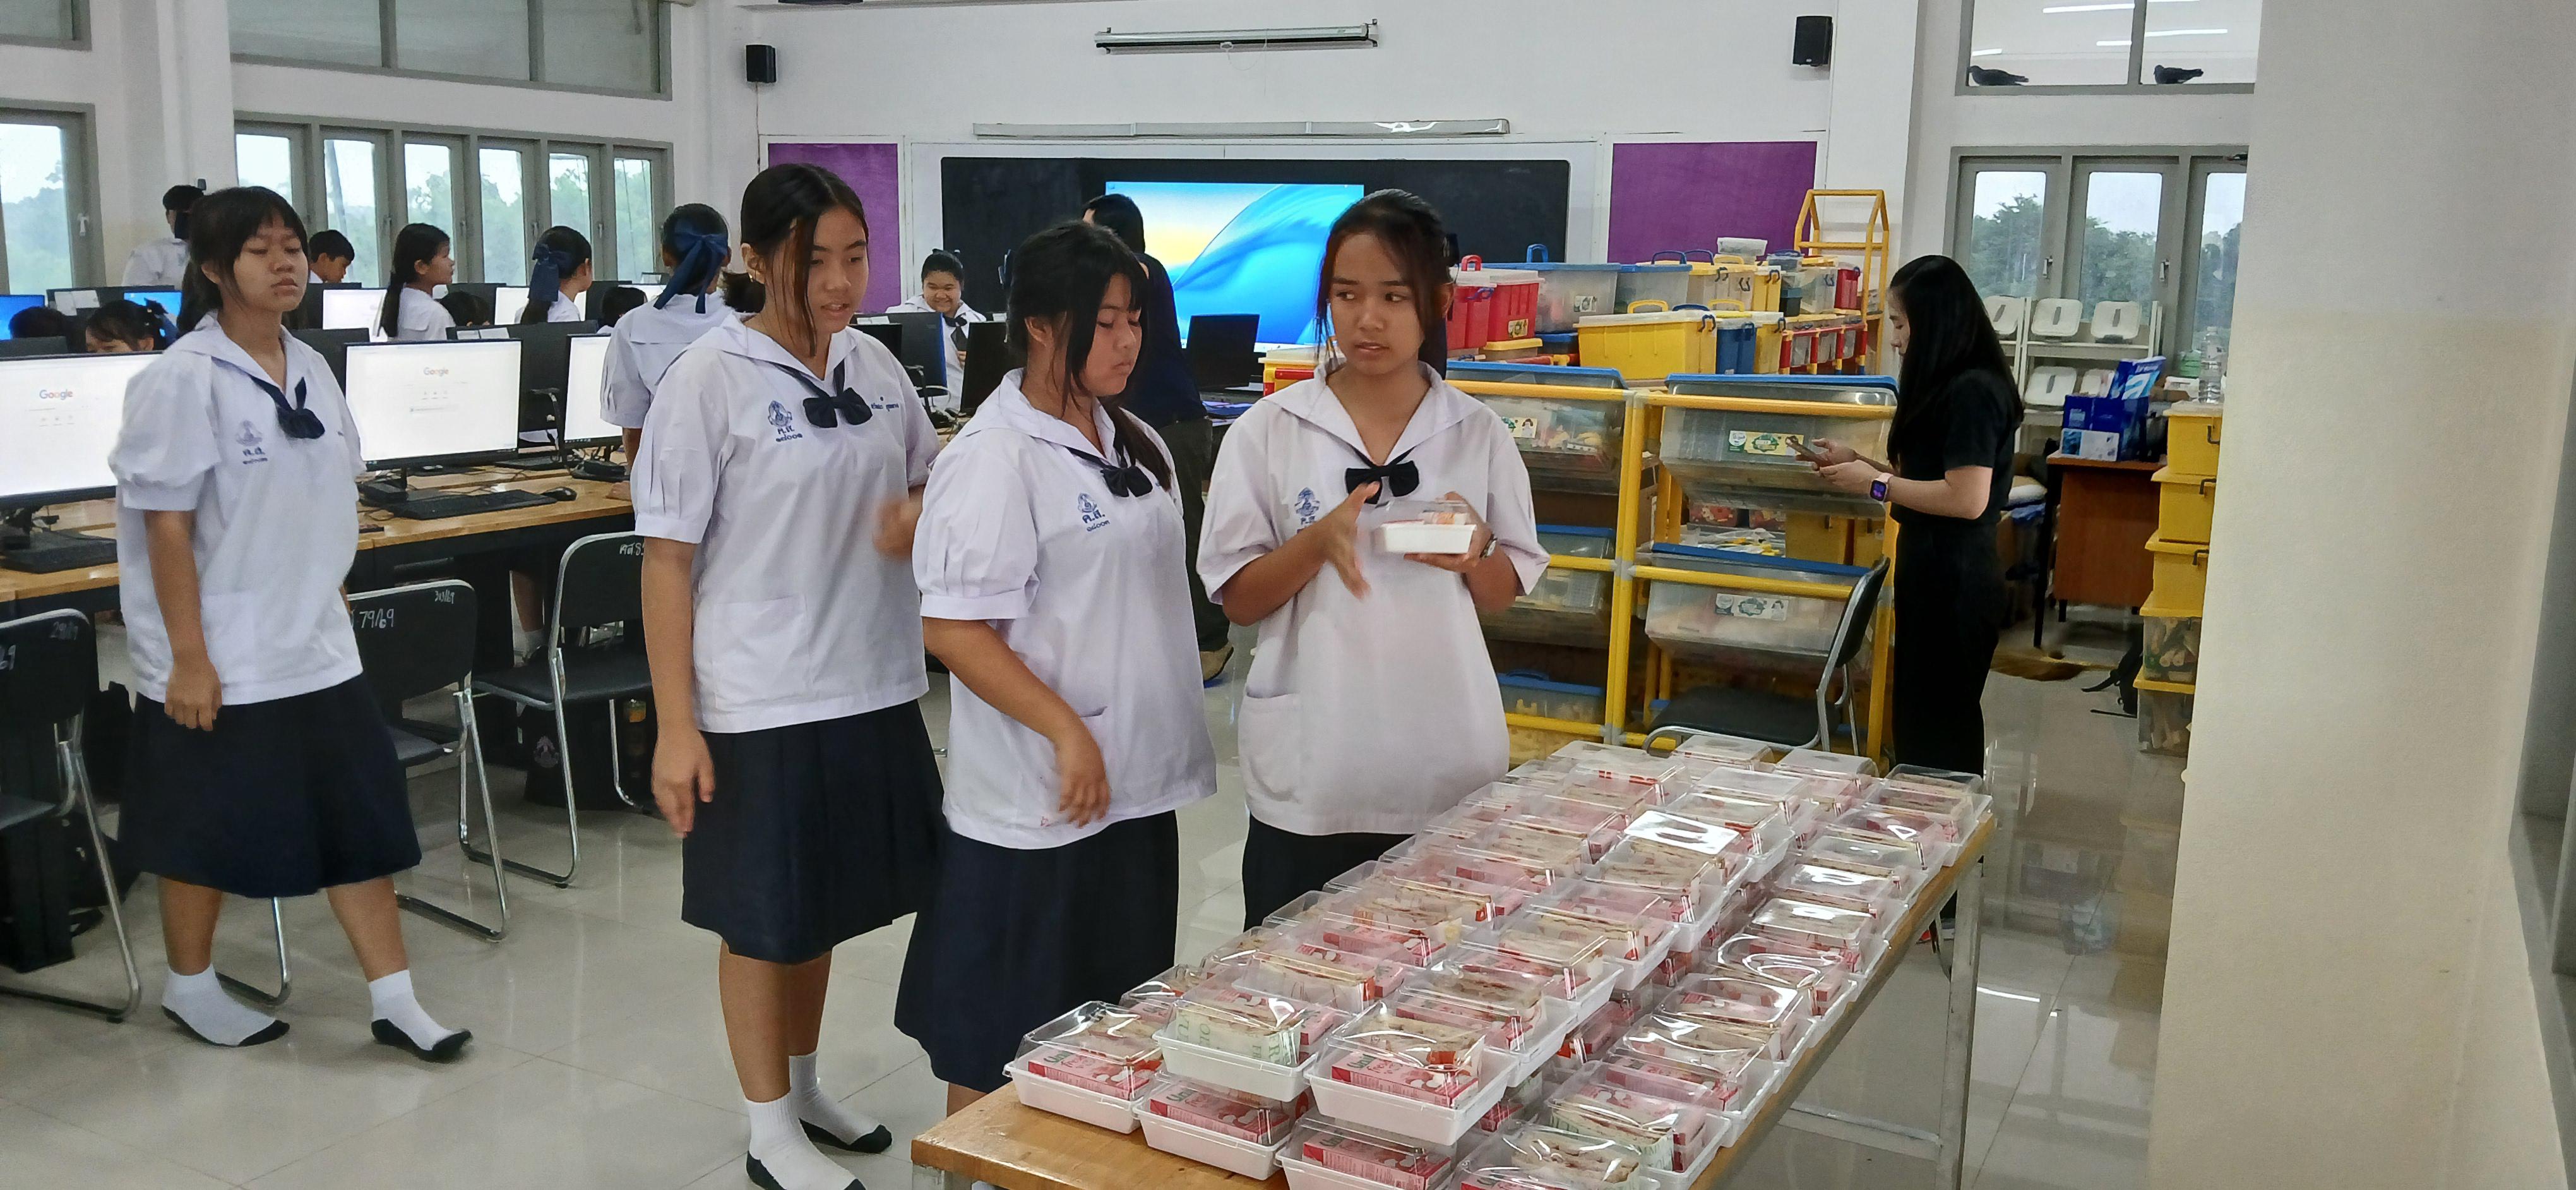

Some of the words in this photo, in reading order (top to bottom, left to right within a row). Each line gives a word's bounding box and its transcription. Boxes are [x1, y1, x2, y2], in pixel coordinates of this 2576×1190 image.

[424, 367, 449, 376] Google
[39, 388, 73, 400] Google
[359, 608, 395, 629] 79/69
